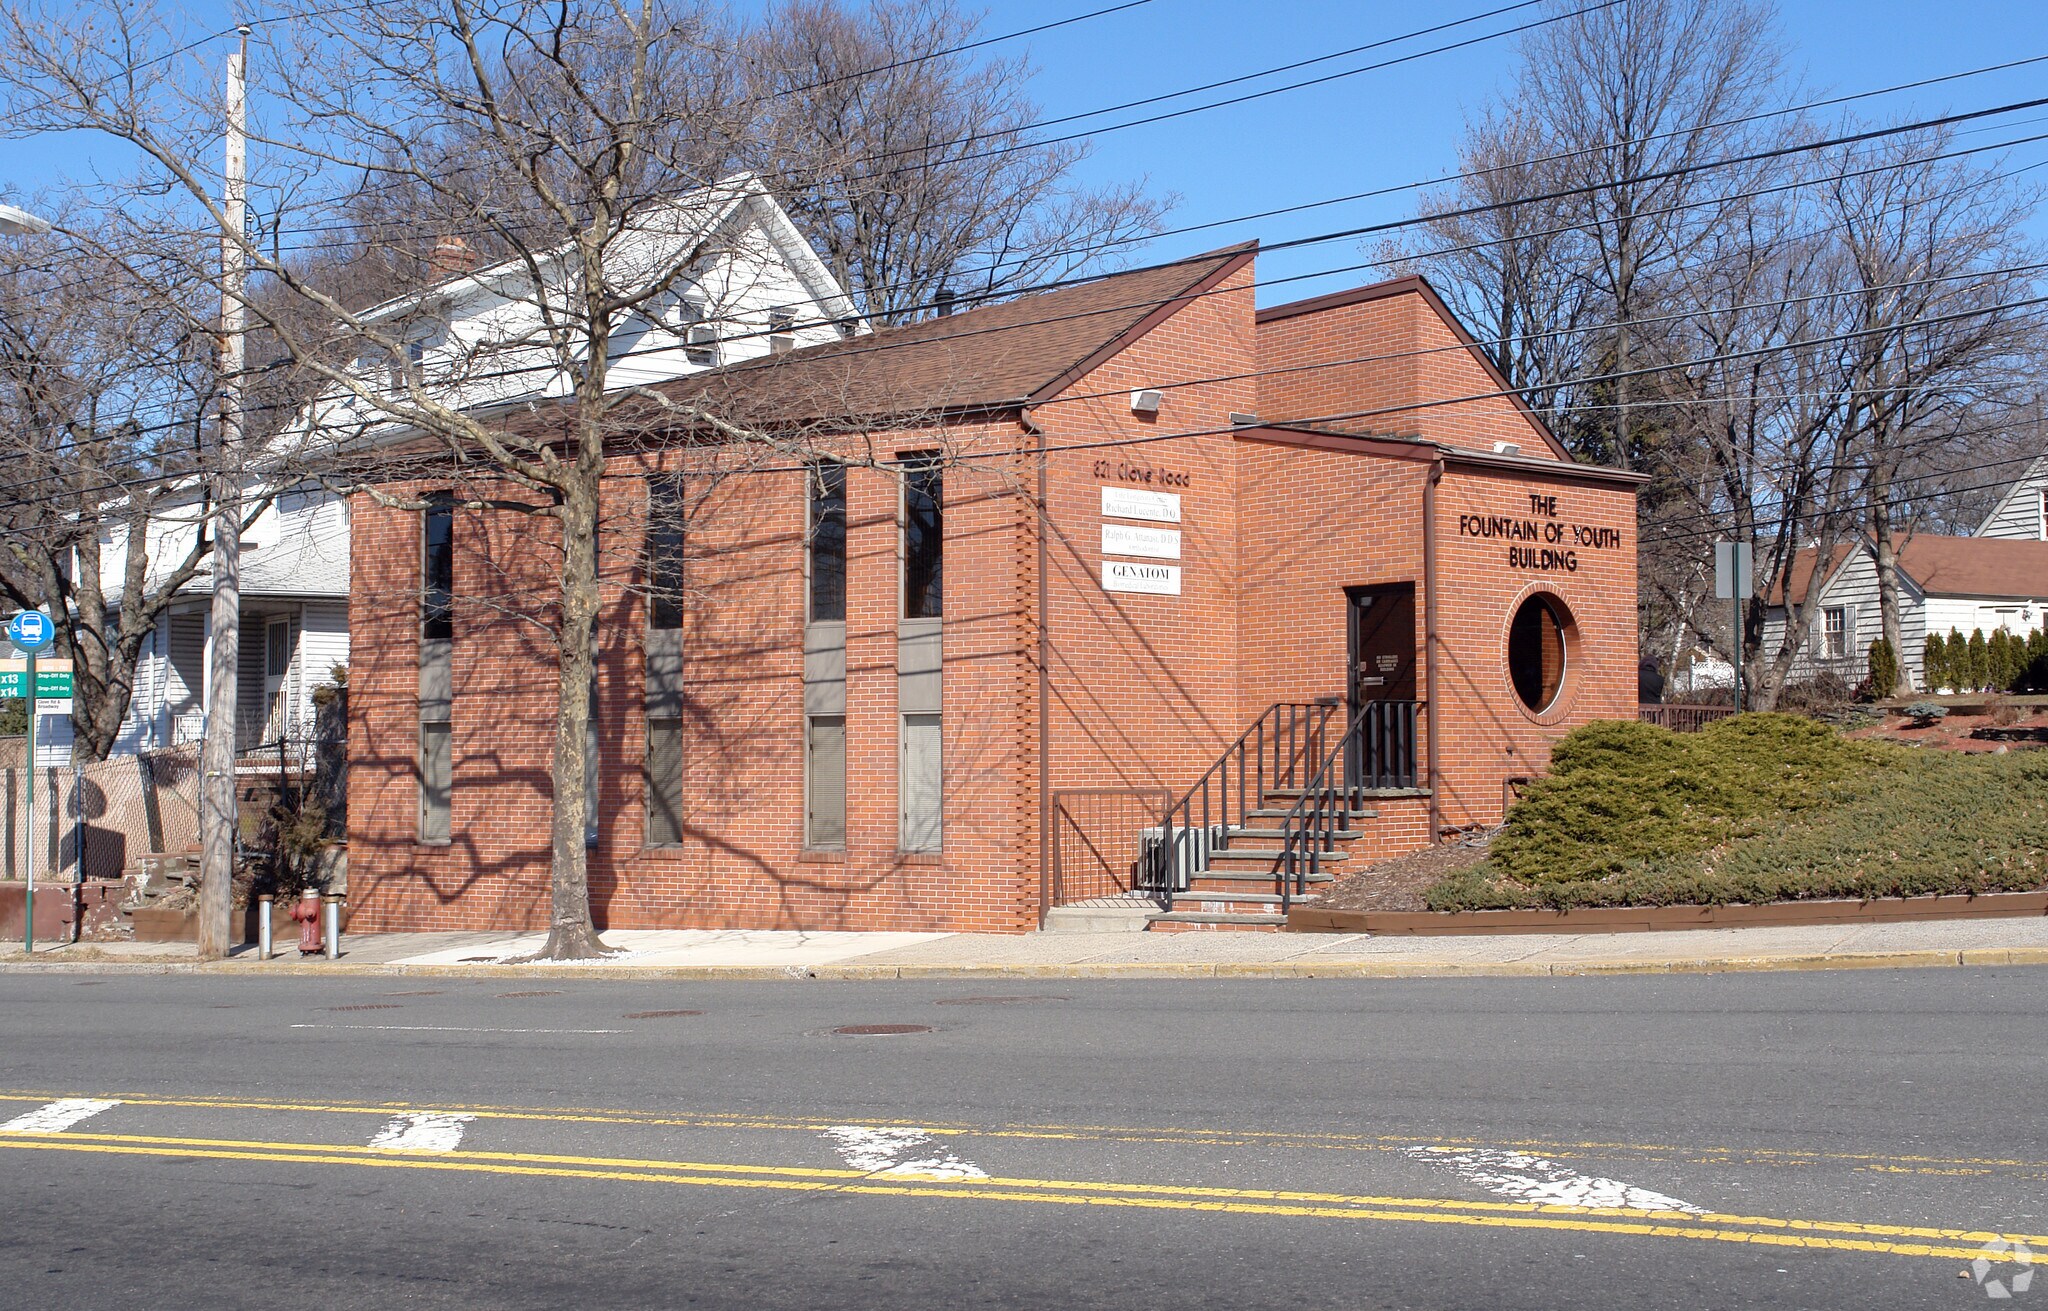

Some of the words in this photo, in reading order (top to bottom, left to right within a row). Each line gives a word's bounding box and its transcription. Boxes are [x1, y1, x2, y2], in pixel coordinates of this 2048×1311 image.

[1118, 462, 1153, 483] Clove
[1106, 502, 1132, 515] Richard
[1529, 494, 1558, 517] THE
[1460, 515, 1538, 541] FOUNTAIN
[1544, 522, 1565, 544] OF
[1572, 524, 1620, 549] YOUTH
[1509, 546, 1578, 572] BUILDING
[1112, 564, 1169, 580] GENATOM
[1, 673, 19, 684] x13
[0, 686, 18, 697] x14
